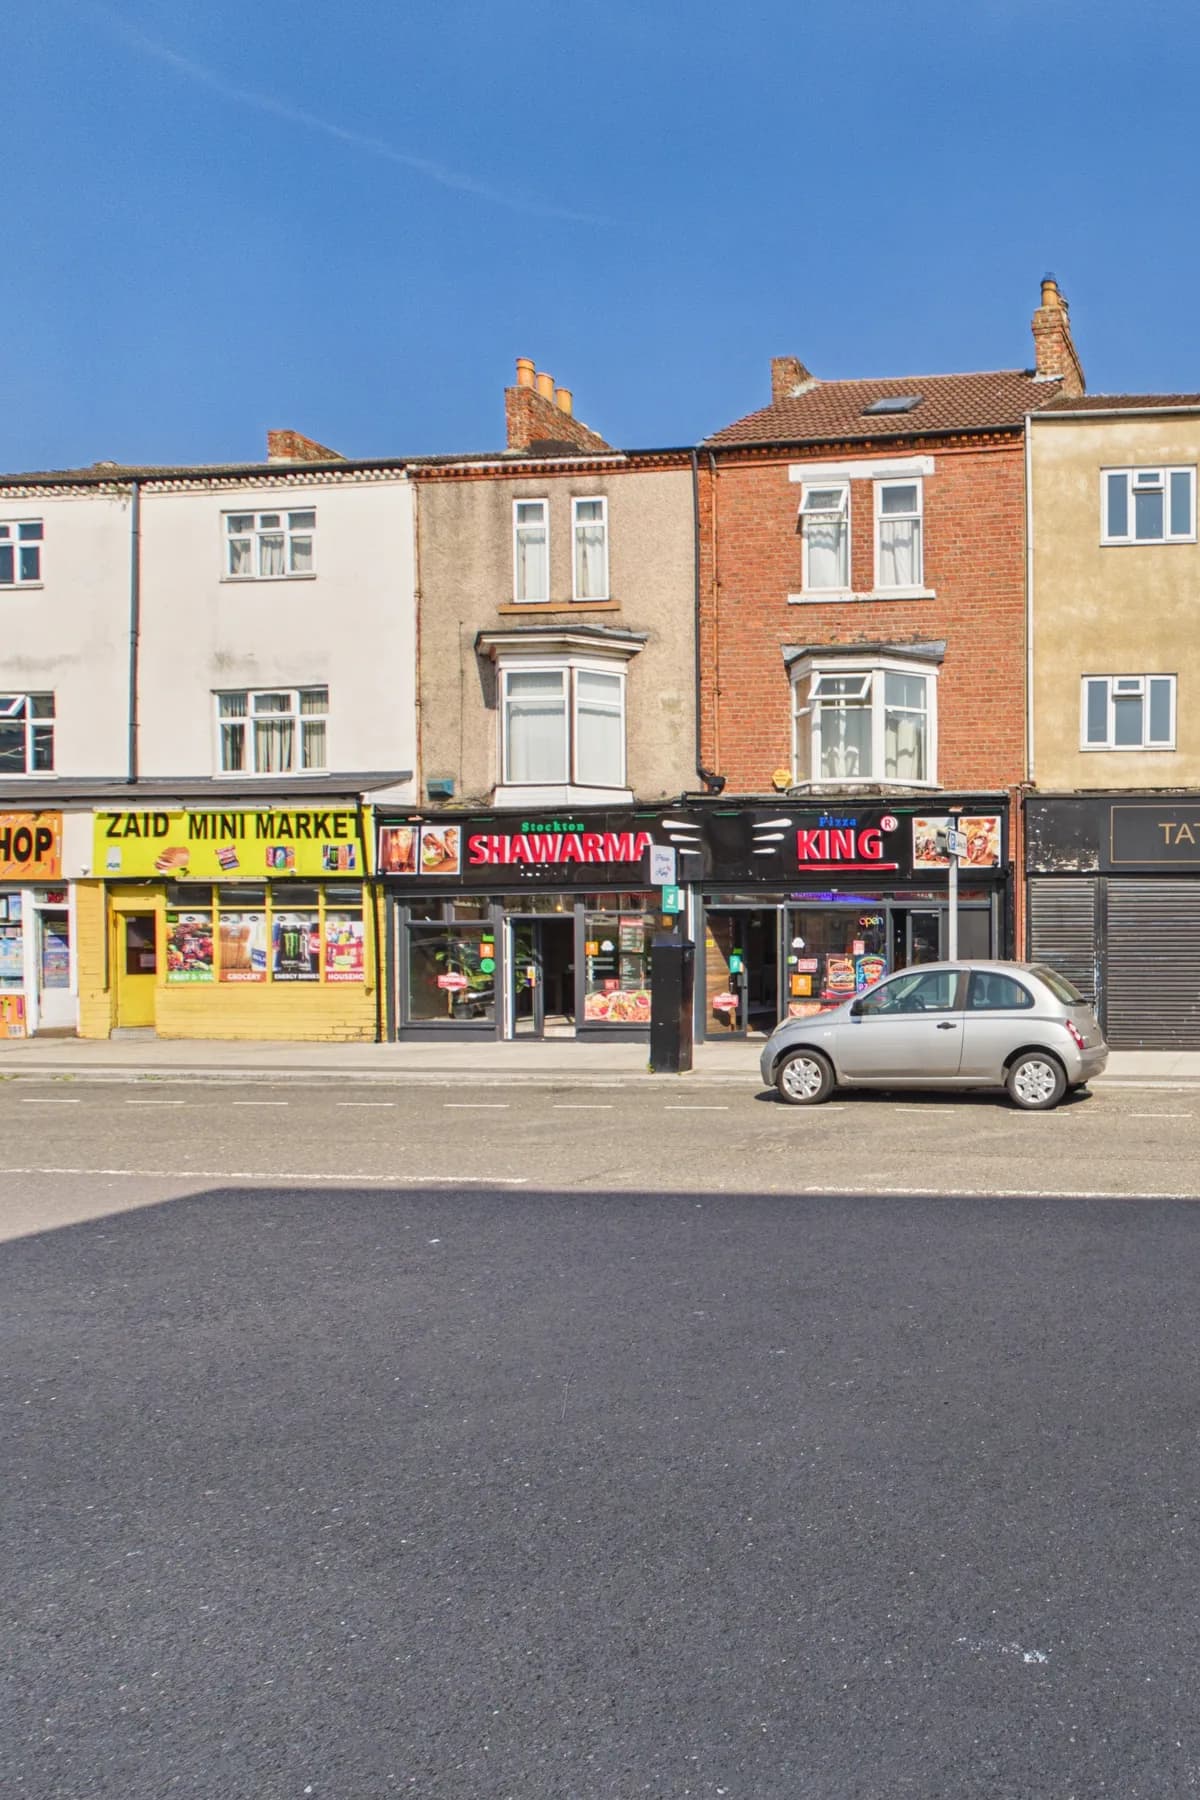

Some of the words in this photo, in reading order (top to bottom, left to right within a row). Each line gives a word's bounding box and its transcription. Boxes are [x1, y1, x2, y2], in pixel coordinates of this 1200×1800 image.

[106, 812, 170, 838] ZAID
[189, 813, 245, 840] MINI
[255, 812, 365, 839] MARKET
[521, 821, 585, 832] Stockton
[818, 816, 857, 827] Pizza
[468, 832, 652, 864] SHAWARMA
[797, 828, 883, 860] KING
[859, 915, 884, 928] open
[227, 972, 261, 980] GROCERY
[274, 972, 297, 980] ENERGY
